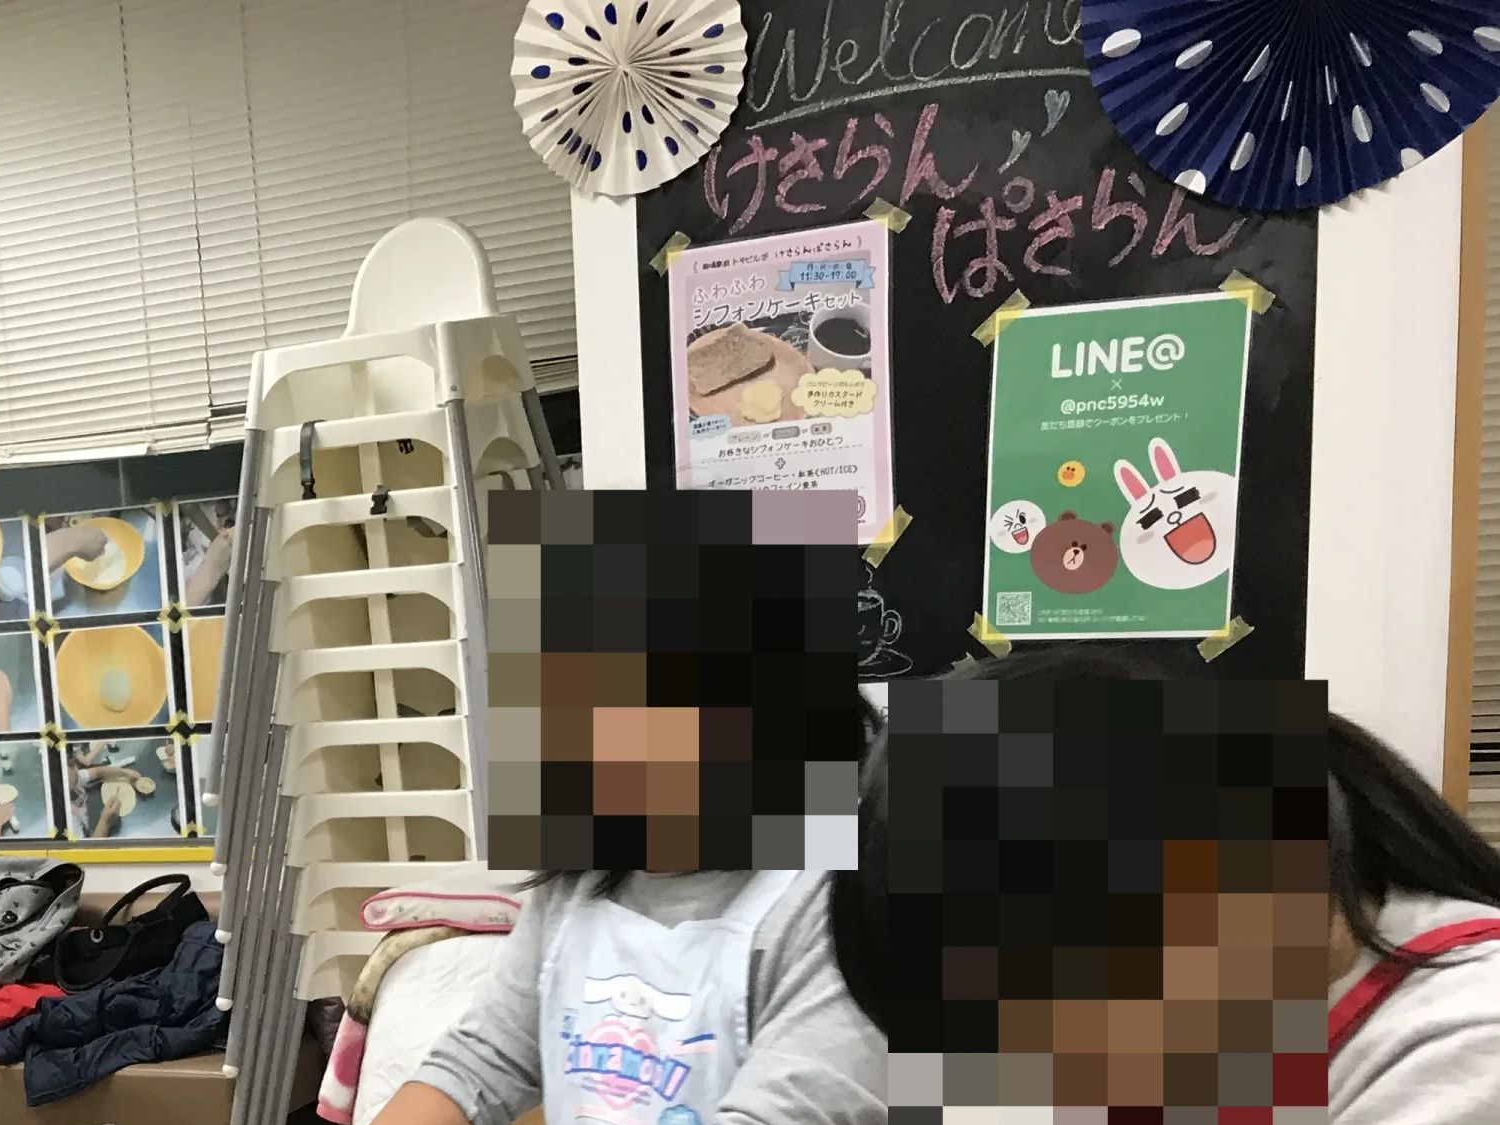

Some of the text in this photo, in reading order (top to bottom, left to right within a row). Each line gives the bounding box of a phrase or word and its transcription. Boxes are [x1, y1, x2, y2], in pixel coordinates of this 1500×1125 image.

[703, 103, 979, 234] けさらん
[930, 168, 1248, 304] ぱさらん
[693, 275, 766, 303] ふわふわ
[693, 291, 861, 327] シフォンケーキセット
[1051, 333, 1186, 378] LINE@
[1060, 393, 1165, 415] @pnc5954w
